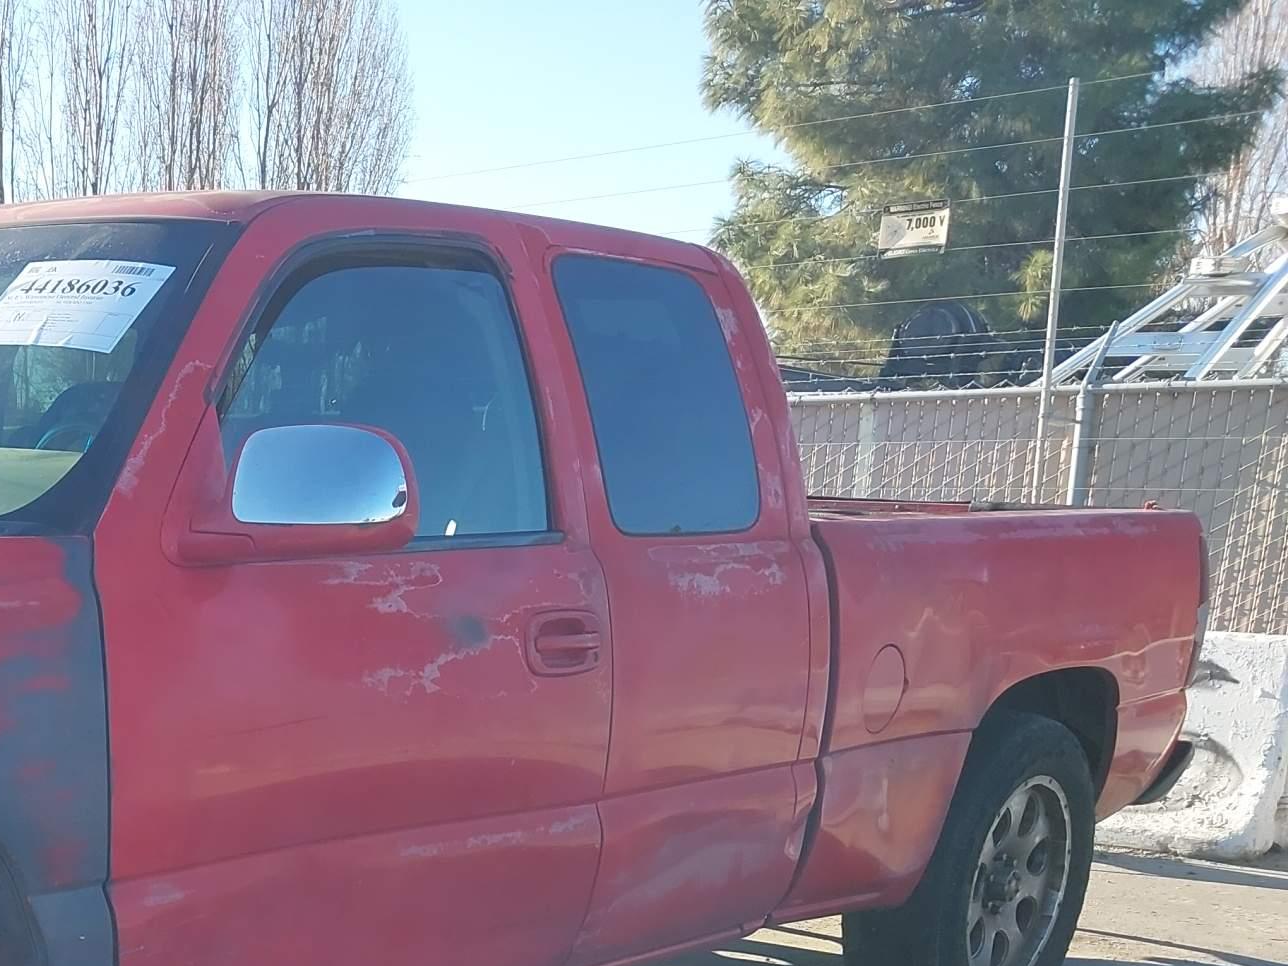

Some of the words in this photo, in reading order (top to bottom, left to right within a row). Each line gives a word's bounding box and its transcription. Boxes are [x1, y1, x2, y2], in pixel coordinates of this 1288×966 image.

[906, 216, 936, 231] 7,000
[939, 214, 945, 227] V
[21, 278, 142, 297] 44186036
